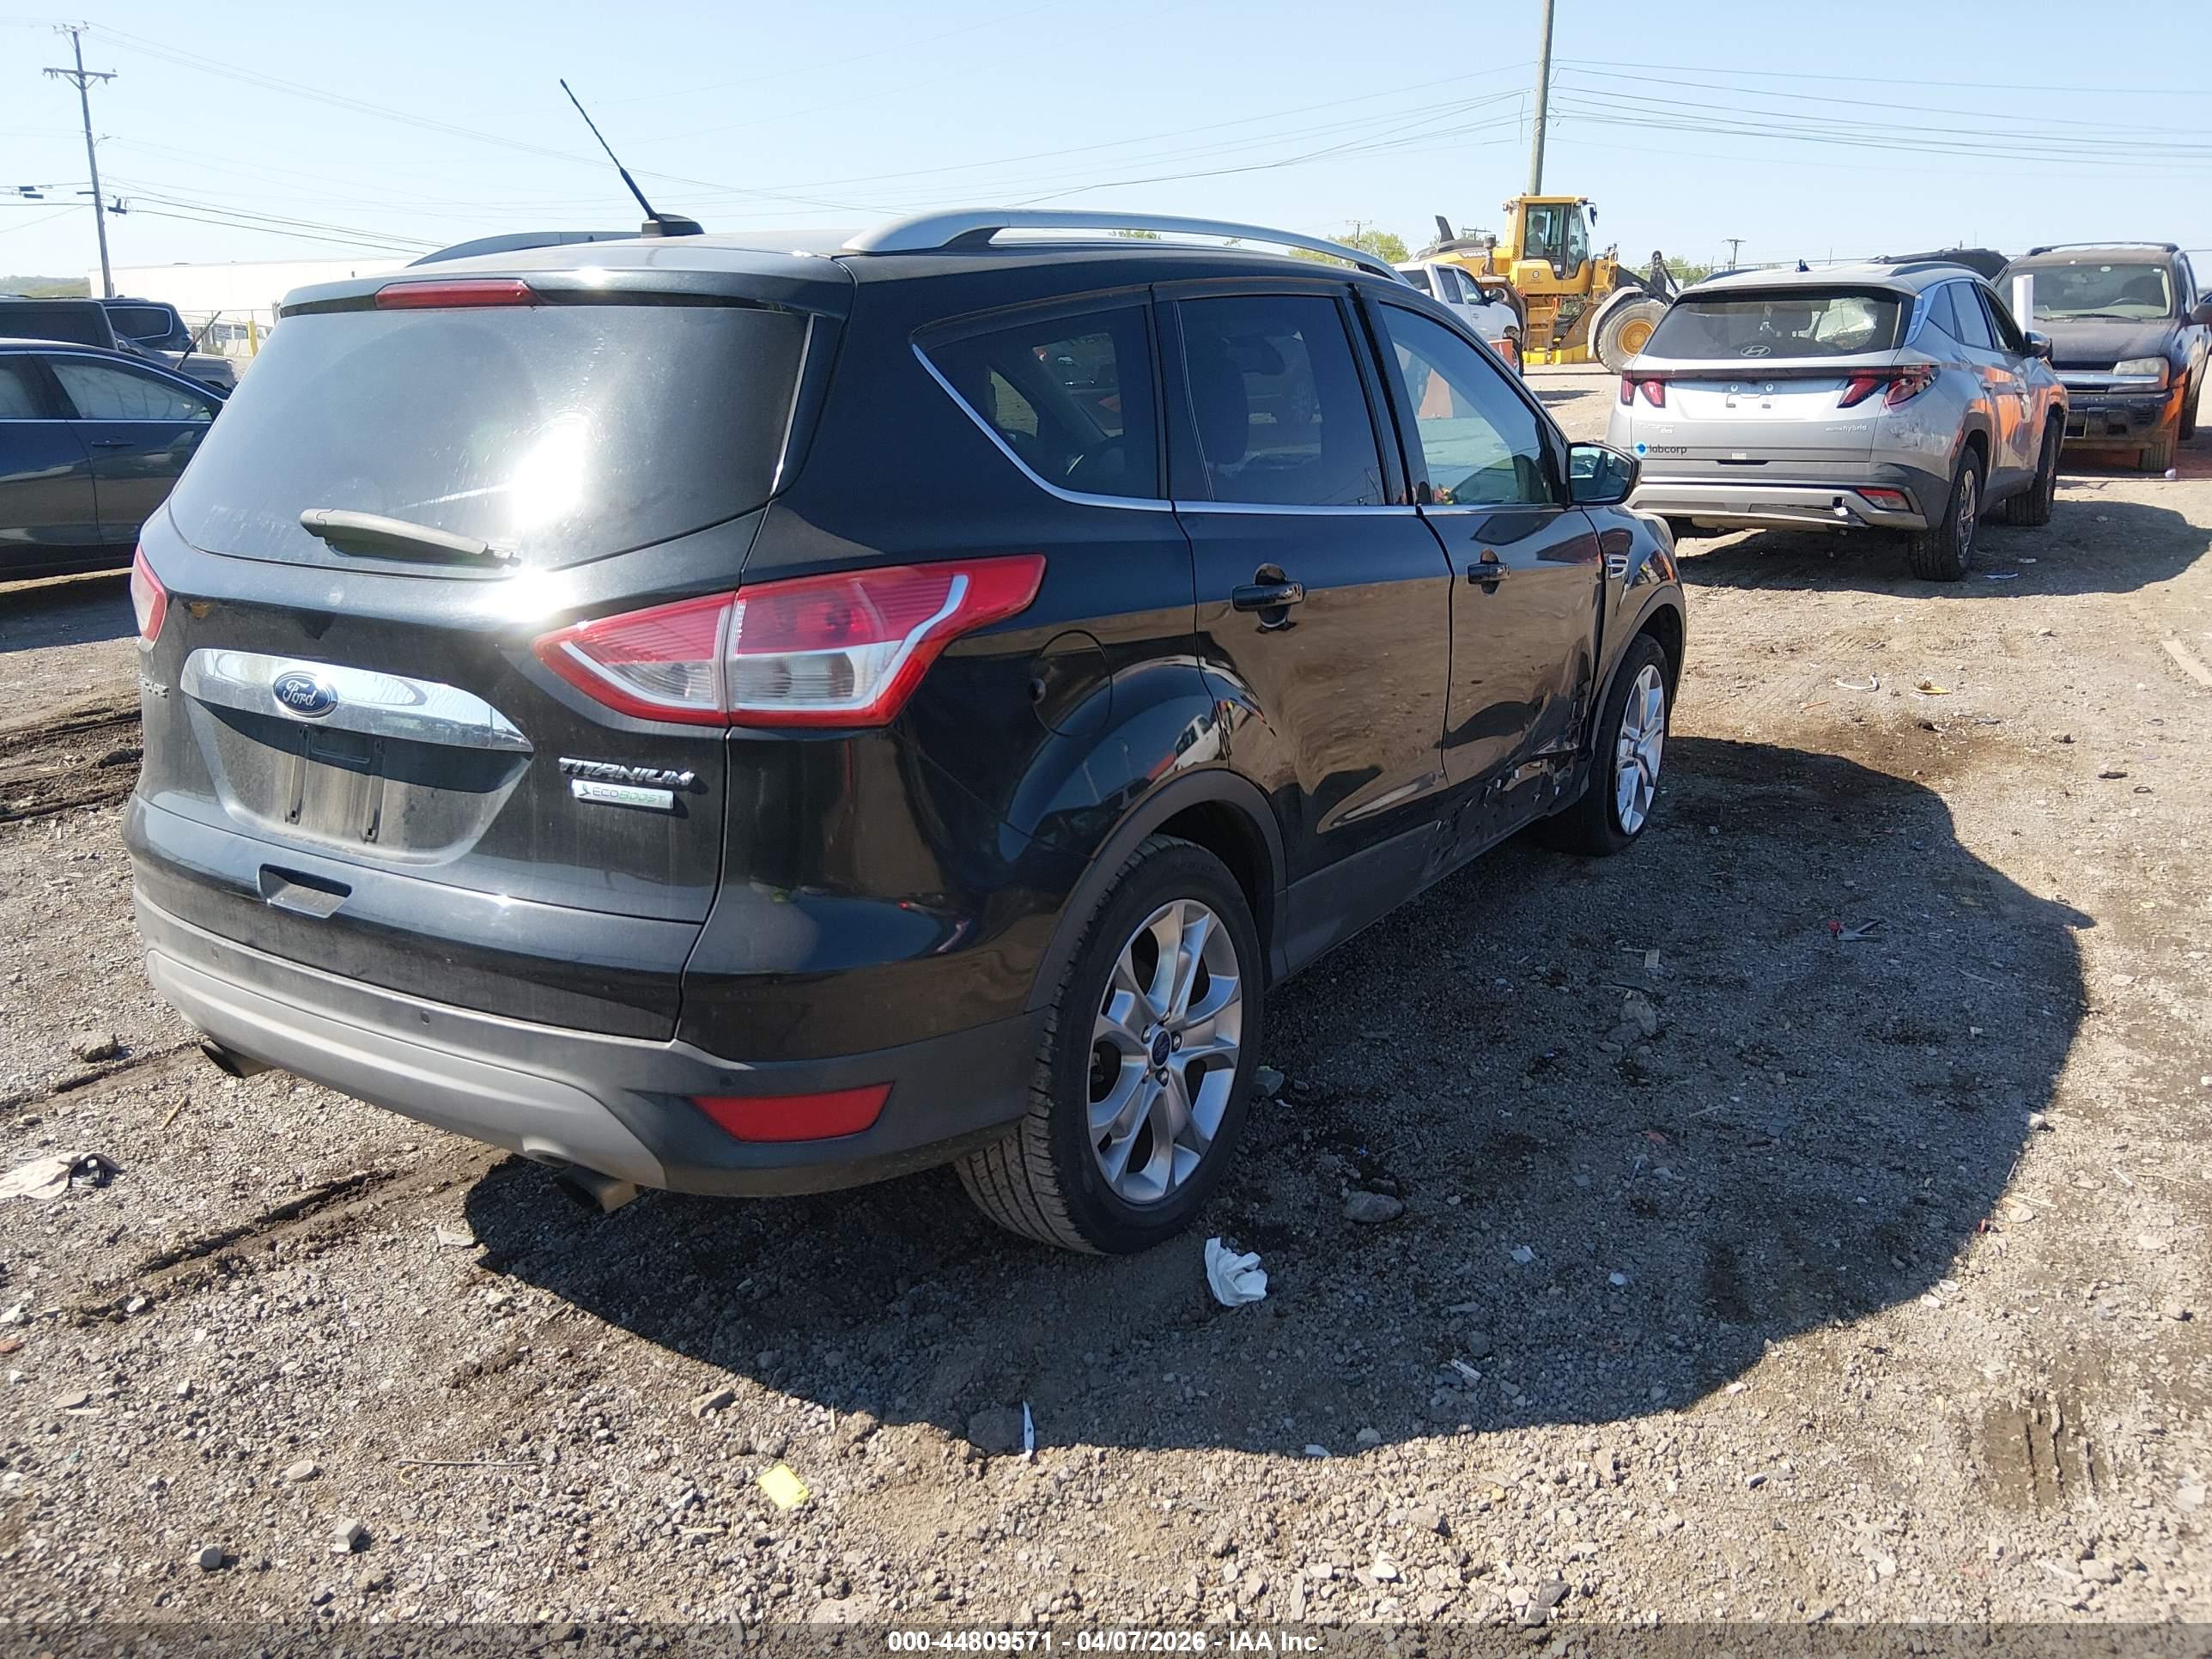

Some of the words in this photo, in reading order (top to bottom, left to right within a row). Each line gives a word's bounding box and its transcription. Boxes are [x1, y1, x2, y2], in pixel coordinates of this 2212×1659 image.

[1649, 444, 1687, 456] labcorp
[282, 679, 318, 707] Ford
[558, 757, 696, 787] TITANIUM
[592, 787, 668, 805] ECOBOOST
